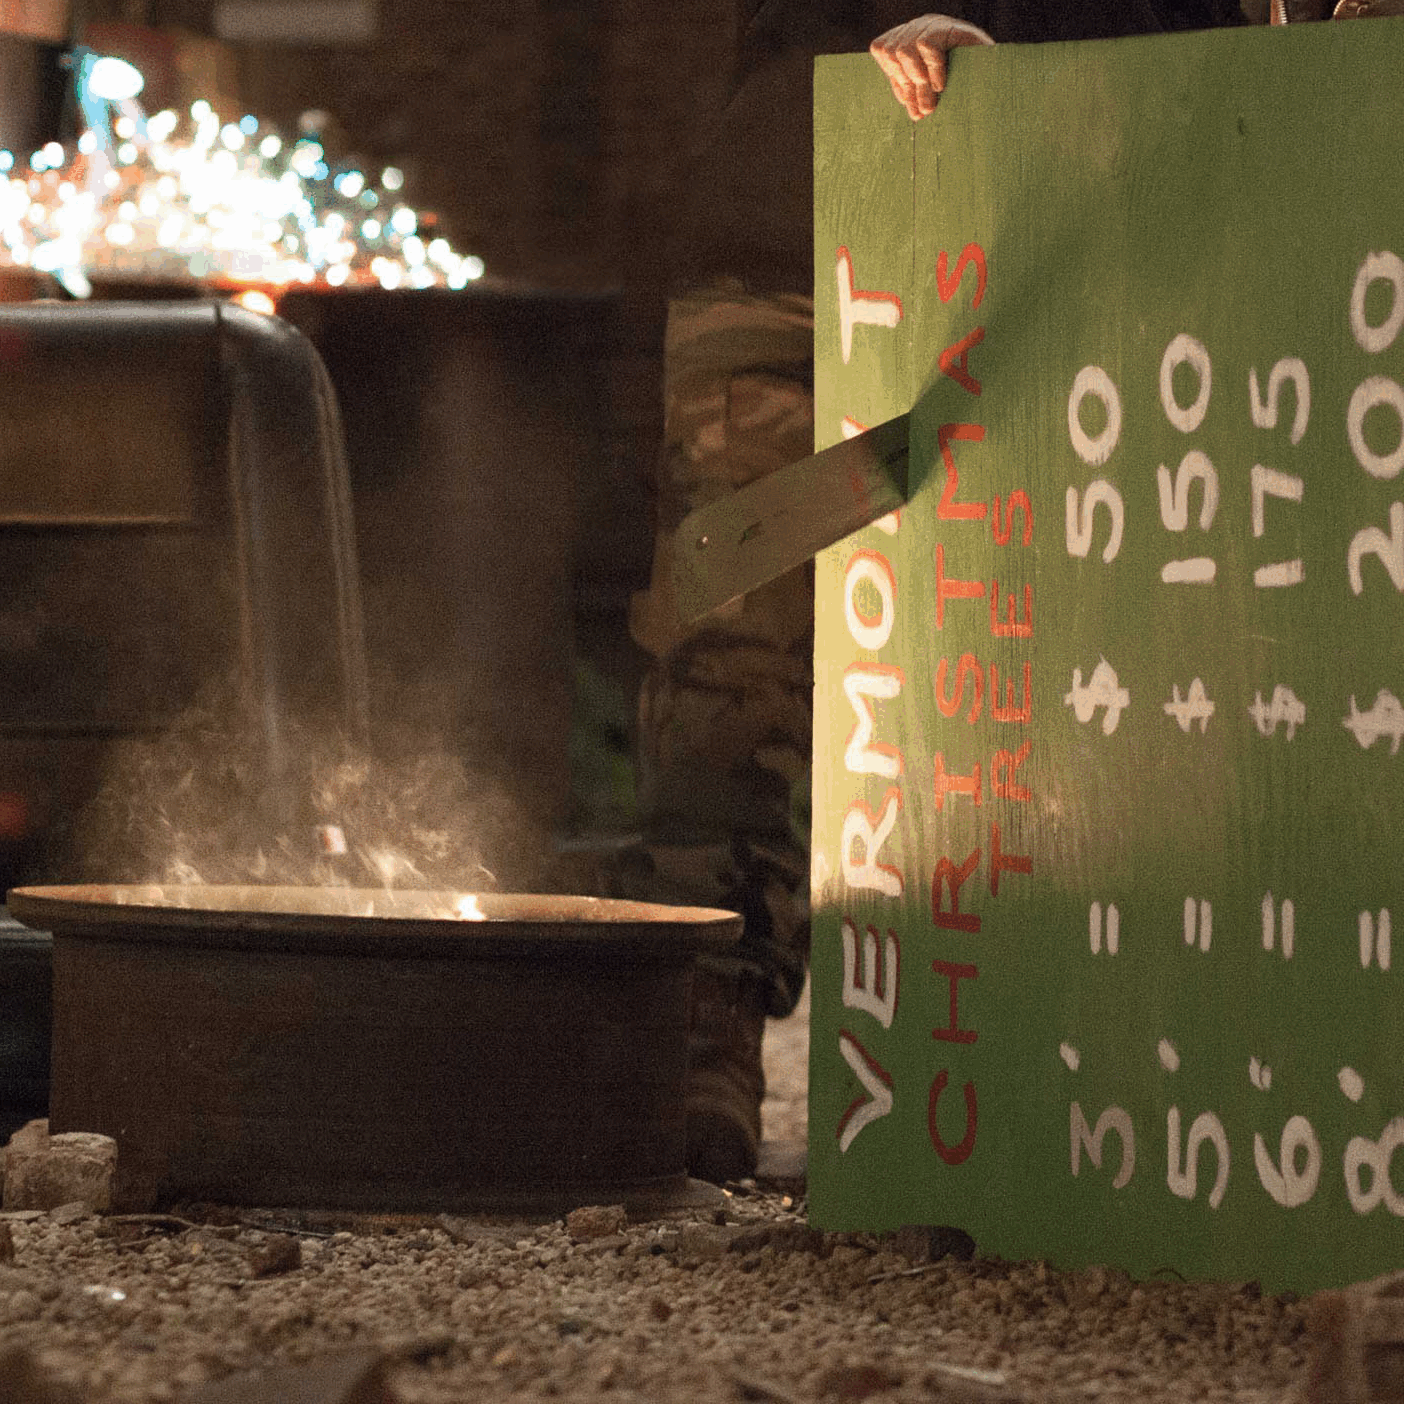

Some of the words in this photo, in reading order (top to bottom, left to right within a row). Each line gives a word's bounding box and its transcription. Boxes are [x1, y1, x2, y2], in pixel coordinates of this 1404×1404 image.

[1064, 363, 1125, 565] 50
[1156, 332, 1220, 585] 150
[1248, 356, 1311, 589] 175
[835, 244, 904, 1154] VERMOT
[927, 241, 989, 1166] CHRISTMAS
[990, 488, 1034, 897] TREES
